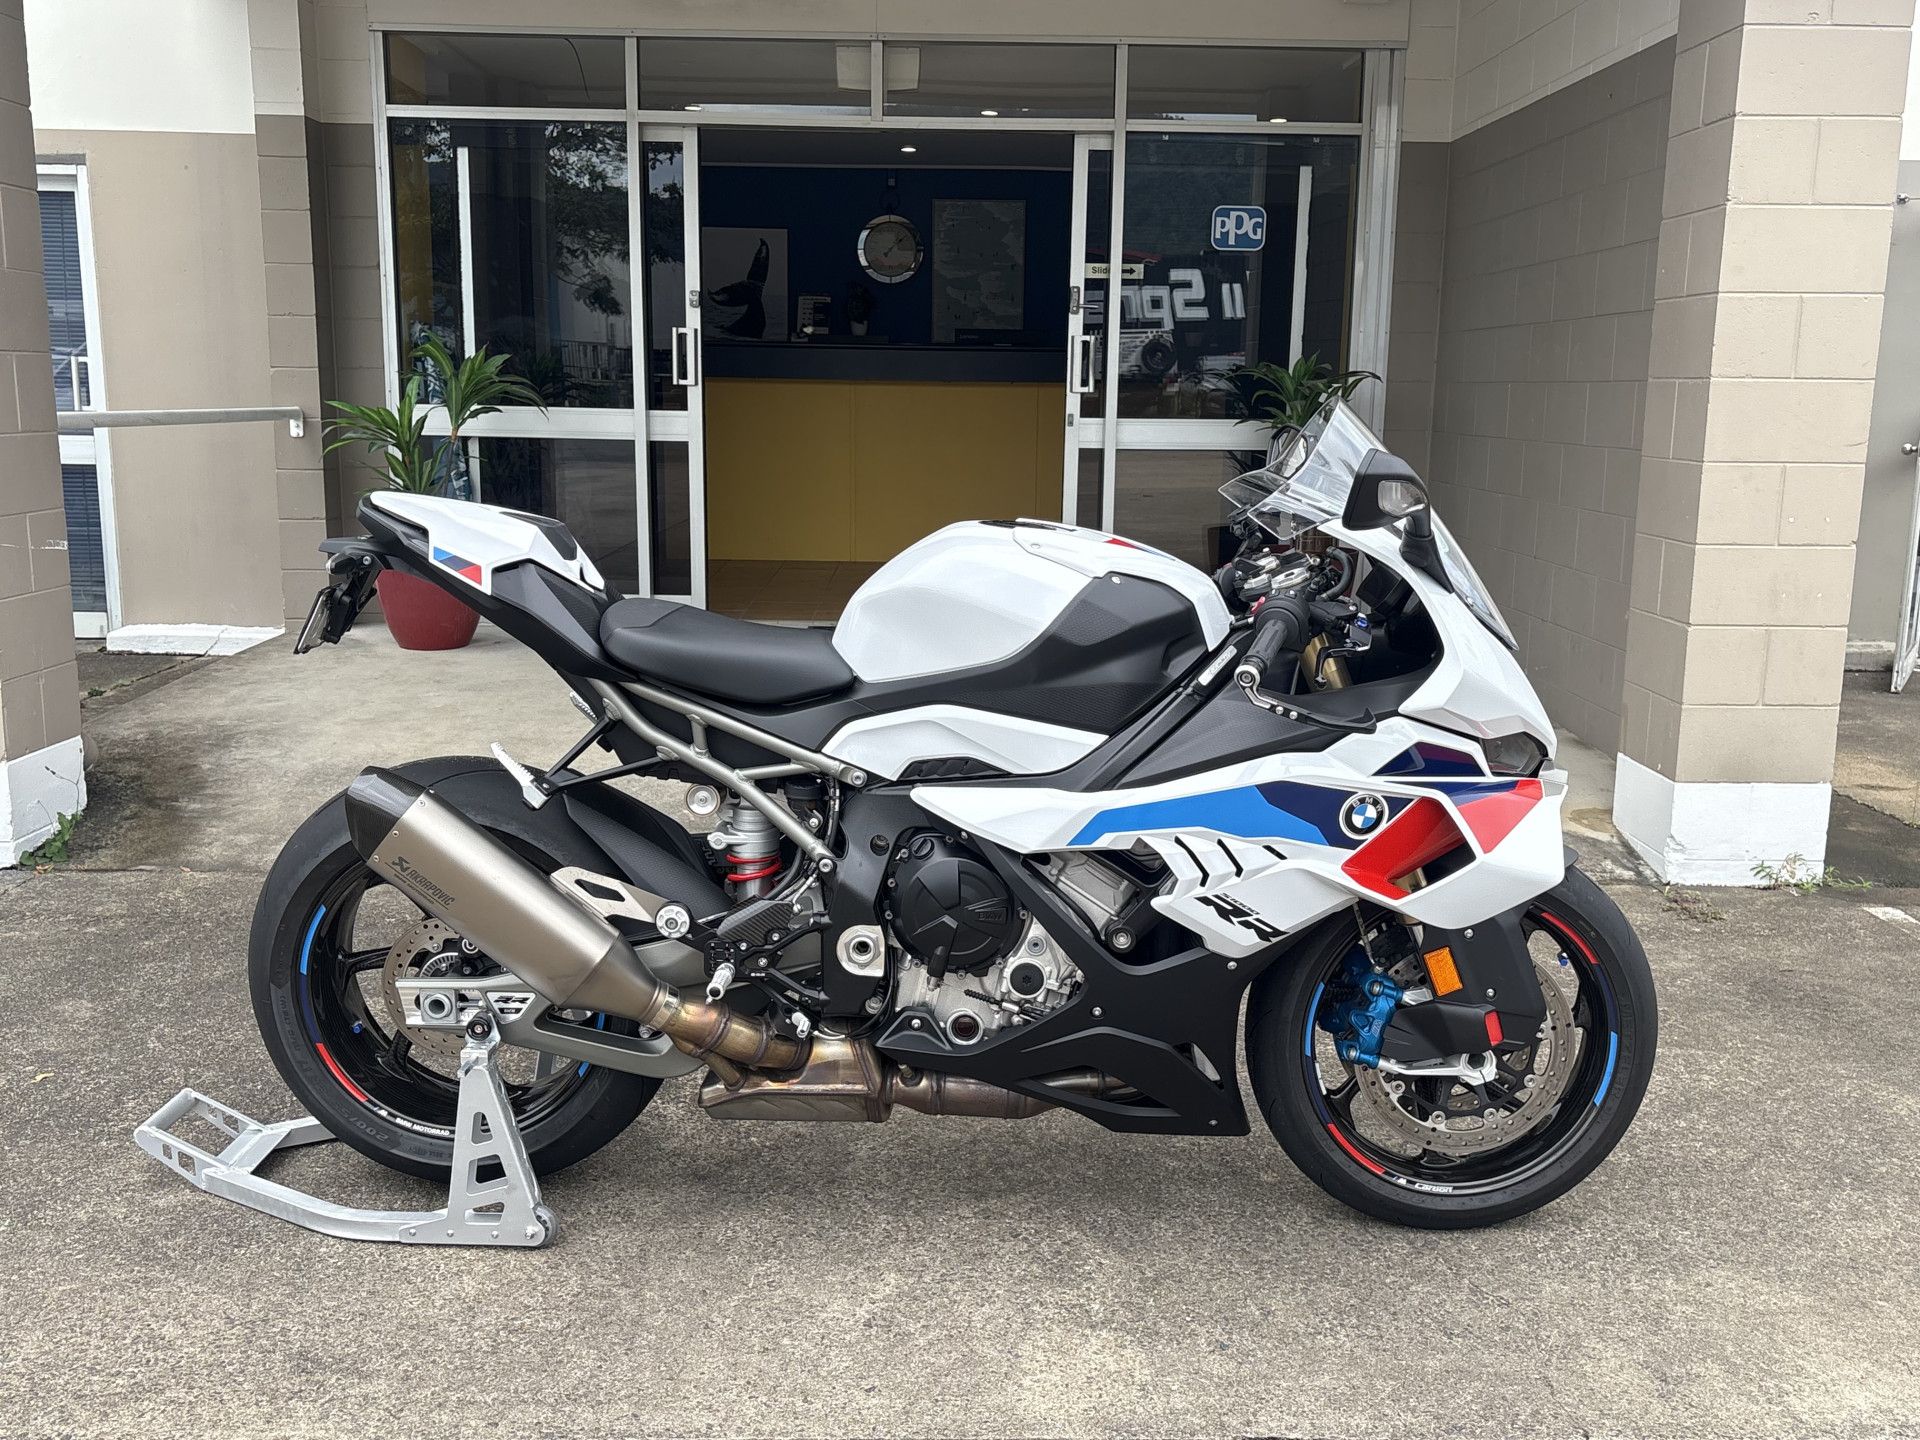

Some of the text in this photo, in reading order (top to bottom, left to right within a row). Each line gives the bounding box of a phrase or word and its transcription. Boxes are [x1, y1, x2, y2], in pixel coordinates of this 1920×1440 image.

[1215, 211, 1263, 245] PPG
[1351, 797, 1383, 812] BMW
[406, 869, 456, 906] AKRAPOVIC
[395, 1117, 413, 1129] BMW
[412, 1124, 450, 1135] MOTORRAD
